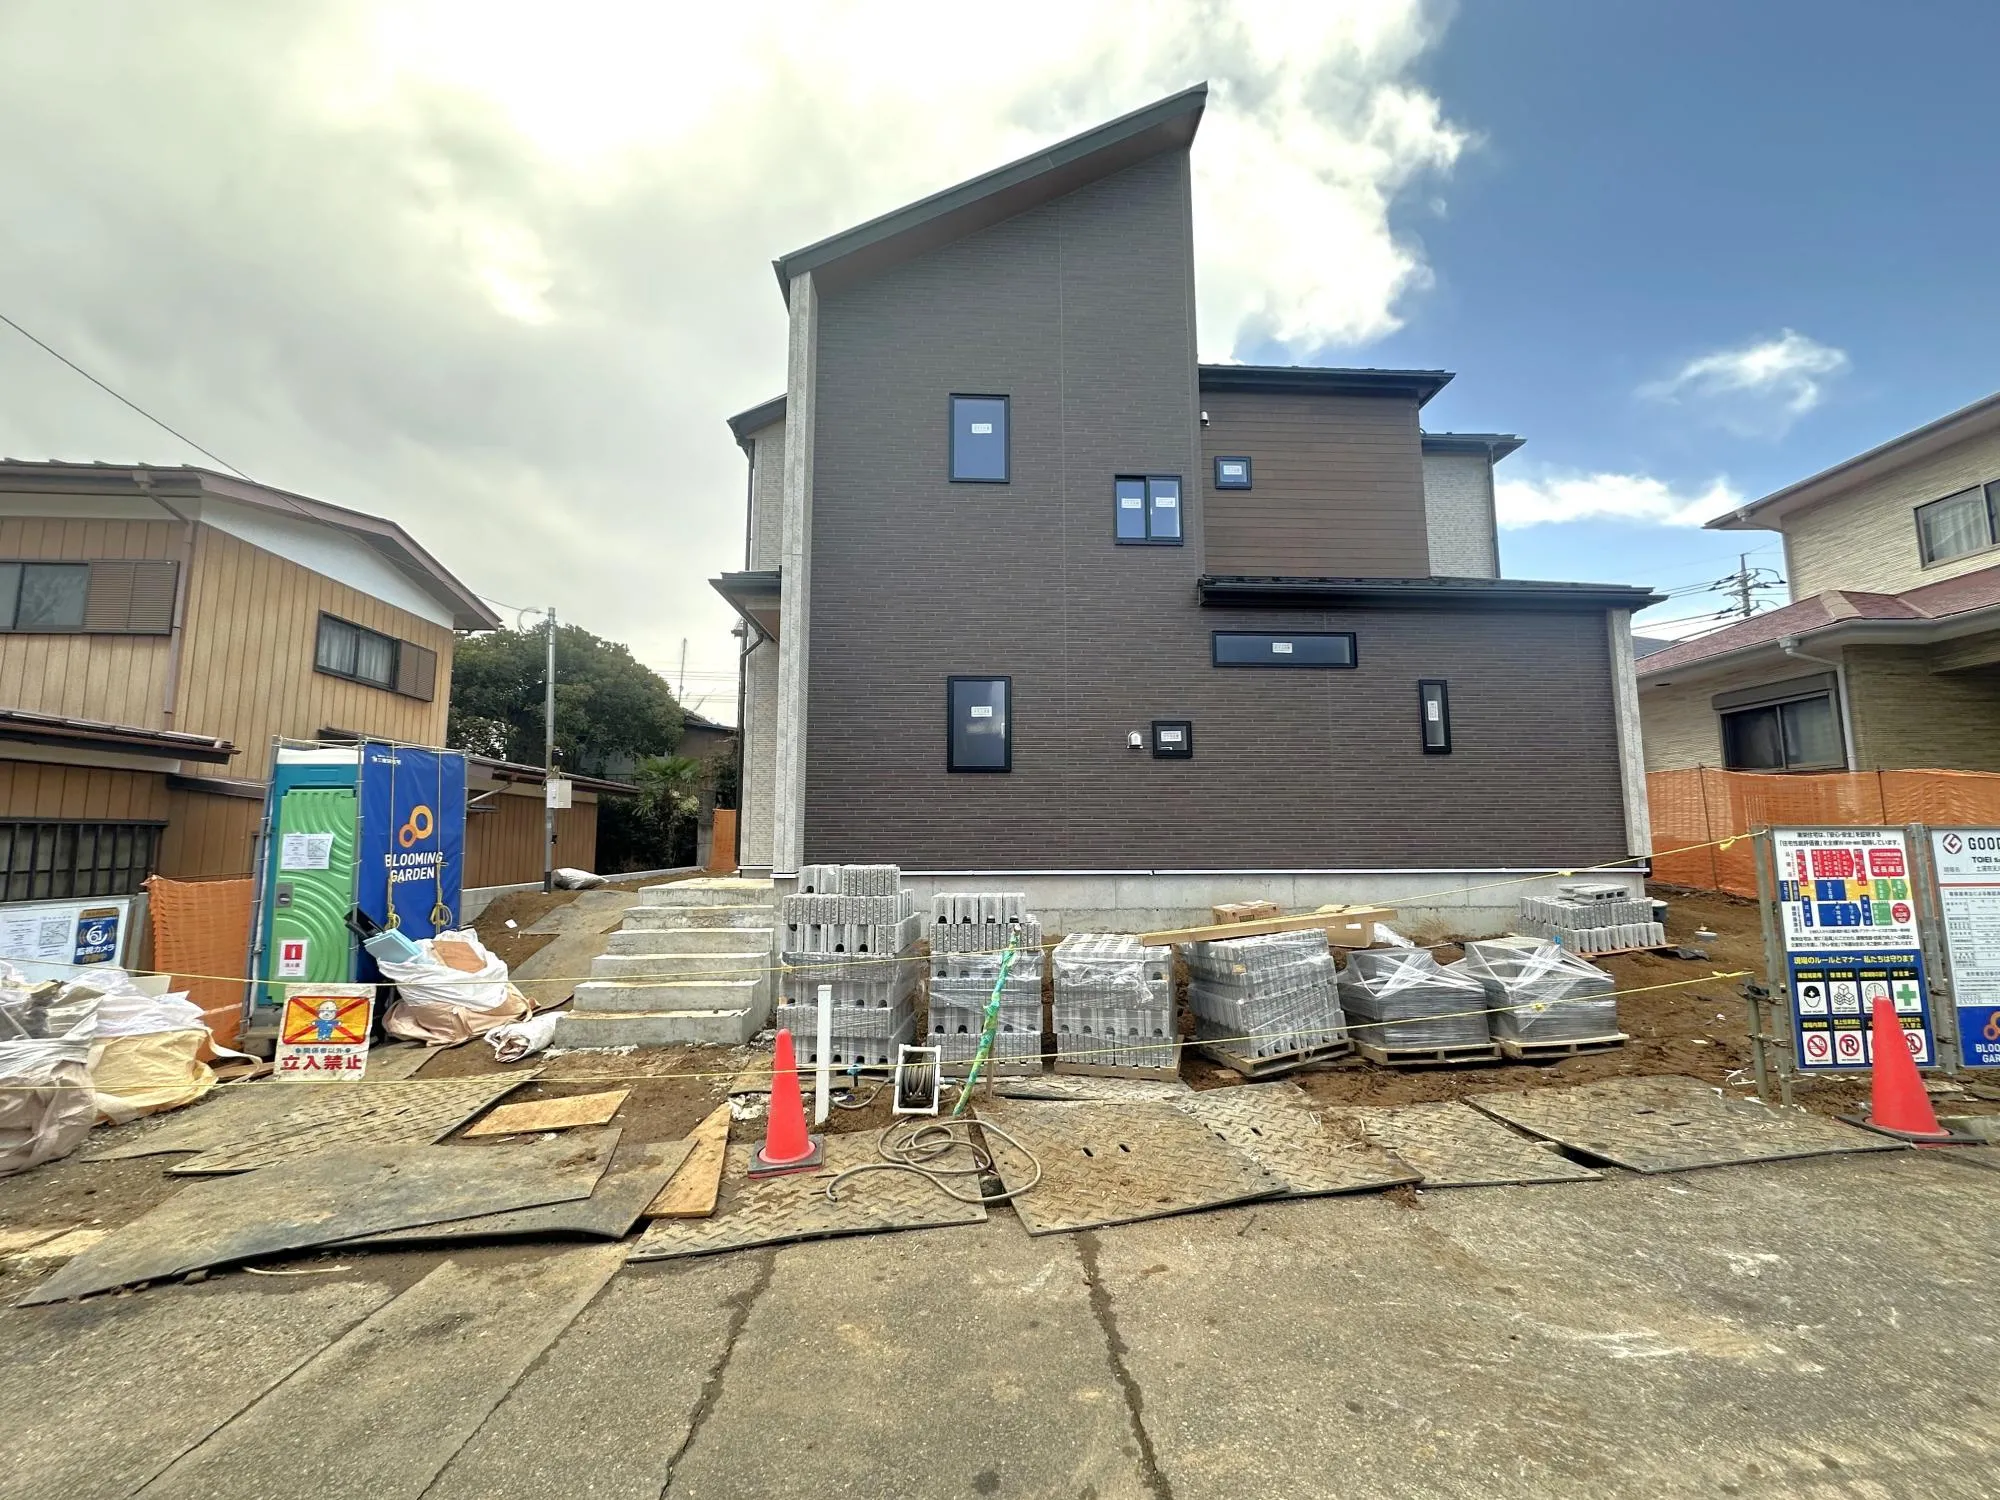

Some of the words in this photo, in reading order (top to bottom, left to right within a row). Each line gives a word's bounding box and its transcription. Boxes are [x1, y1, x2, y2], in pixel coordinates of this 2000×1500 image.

[385, 851, 443, 867] BLOOMING
[390, 867, 435, 882] GARDEN
[280, 1055, 362, 1071] 立入禁止
